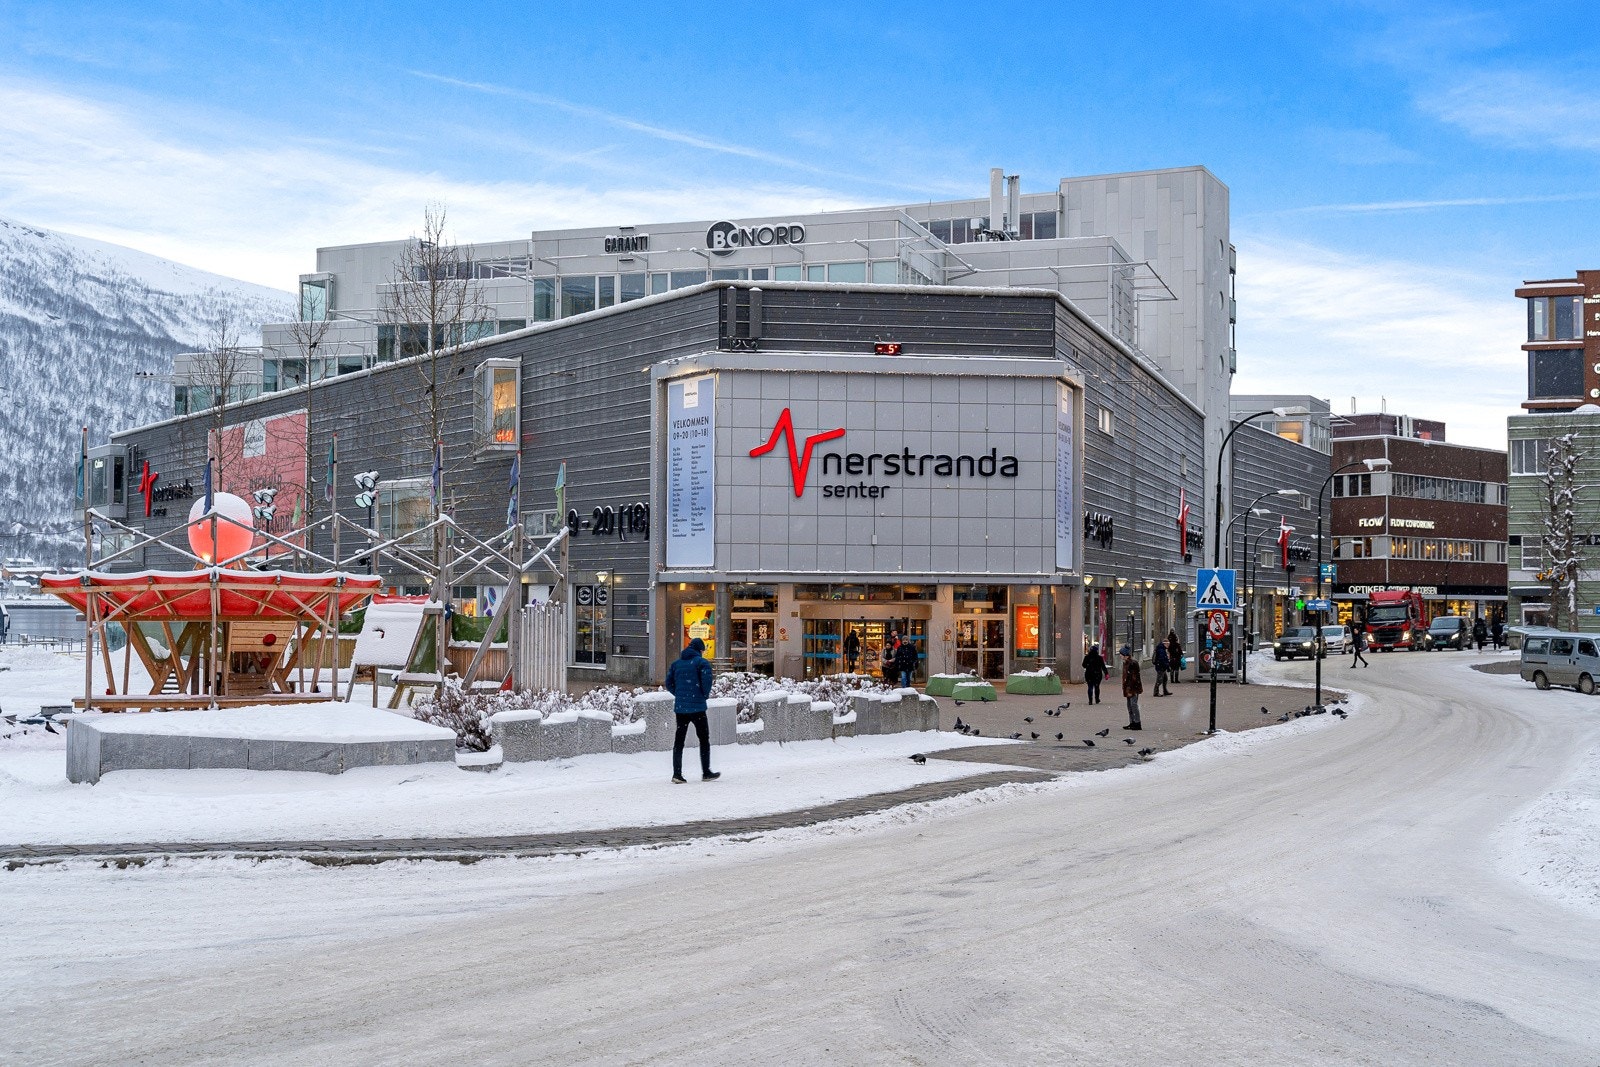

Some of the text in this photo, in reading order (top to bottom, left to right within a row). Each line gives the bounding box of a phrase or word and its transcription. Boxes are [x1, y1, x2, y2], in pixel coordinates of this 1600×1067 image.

[604, 233, 649, 253] GARANTI
[672, 415, 710, 430] VELKOMMEN
[822, 446, 1019, 477] nerstranda
[822, 480, 890, 498] senter
[1358, 516, 1384, 527] FLOW
[1348, 585, 1386, 595] OPTIKER
